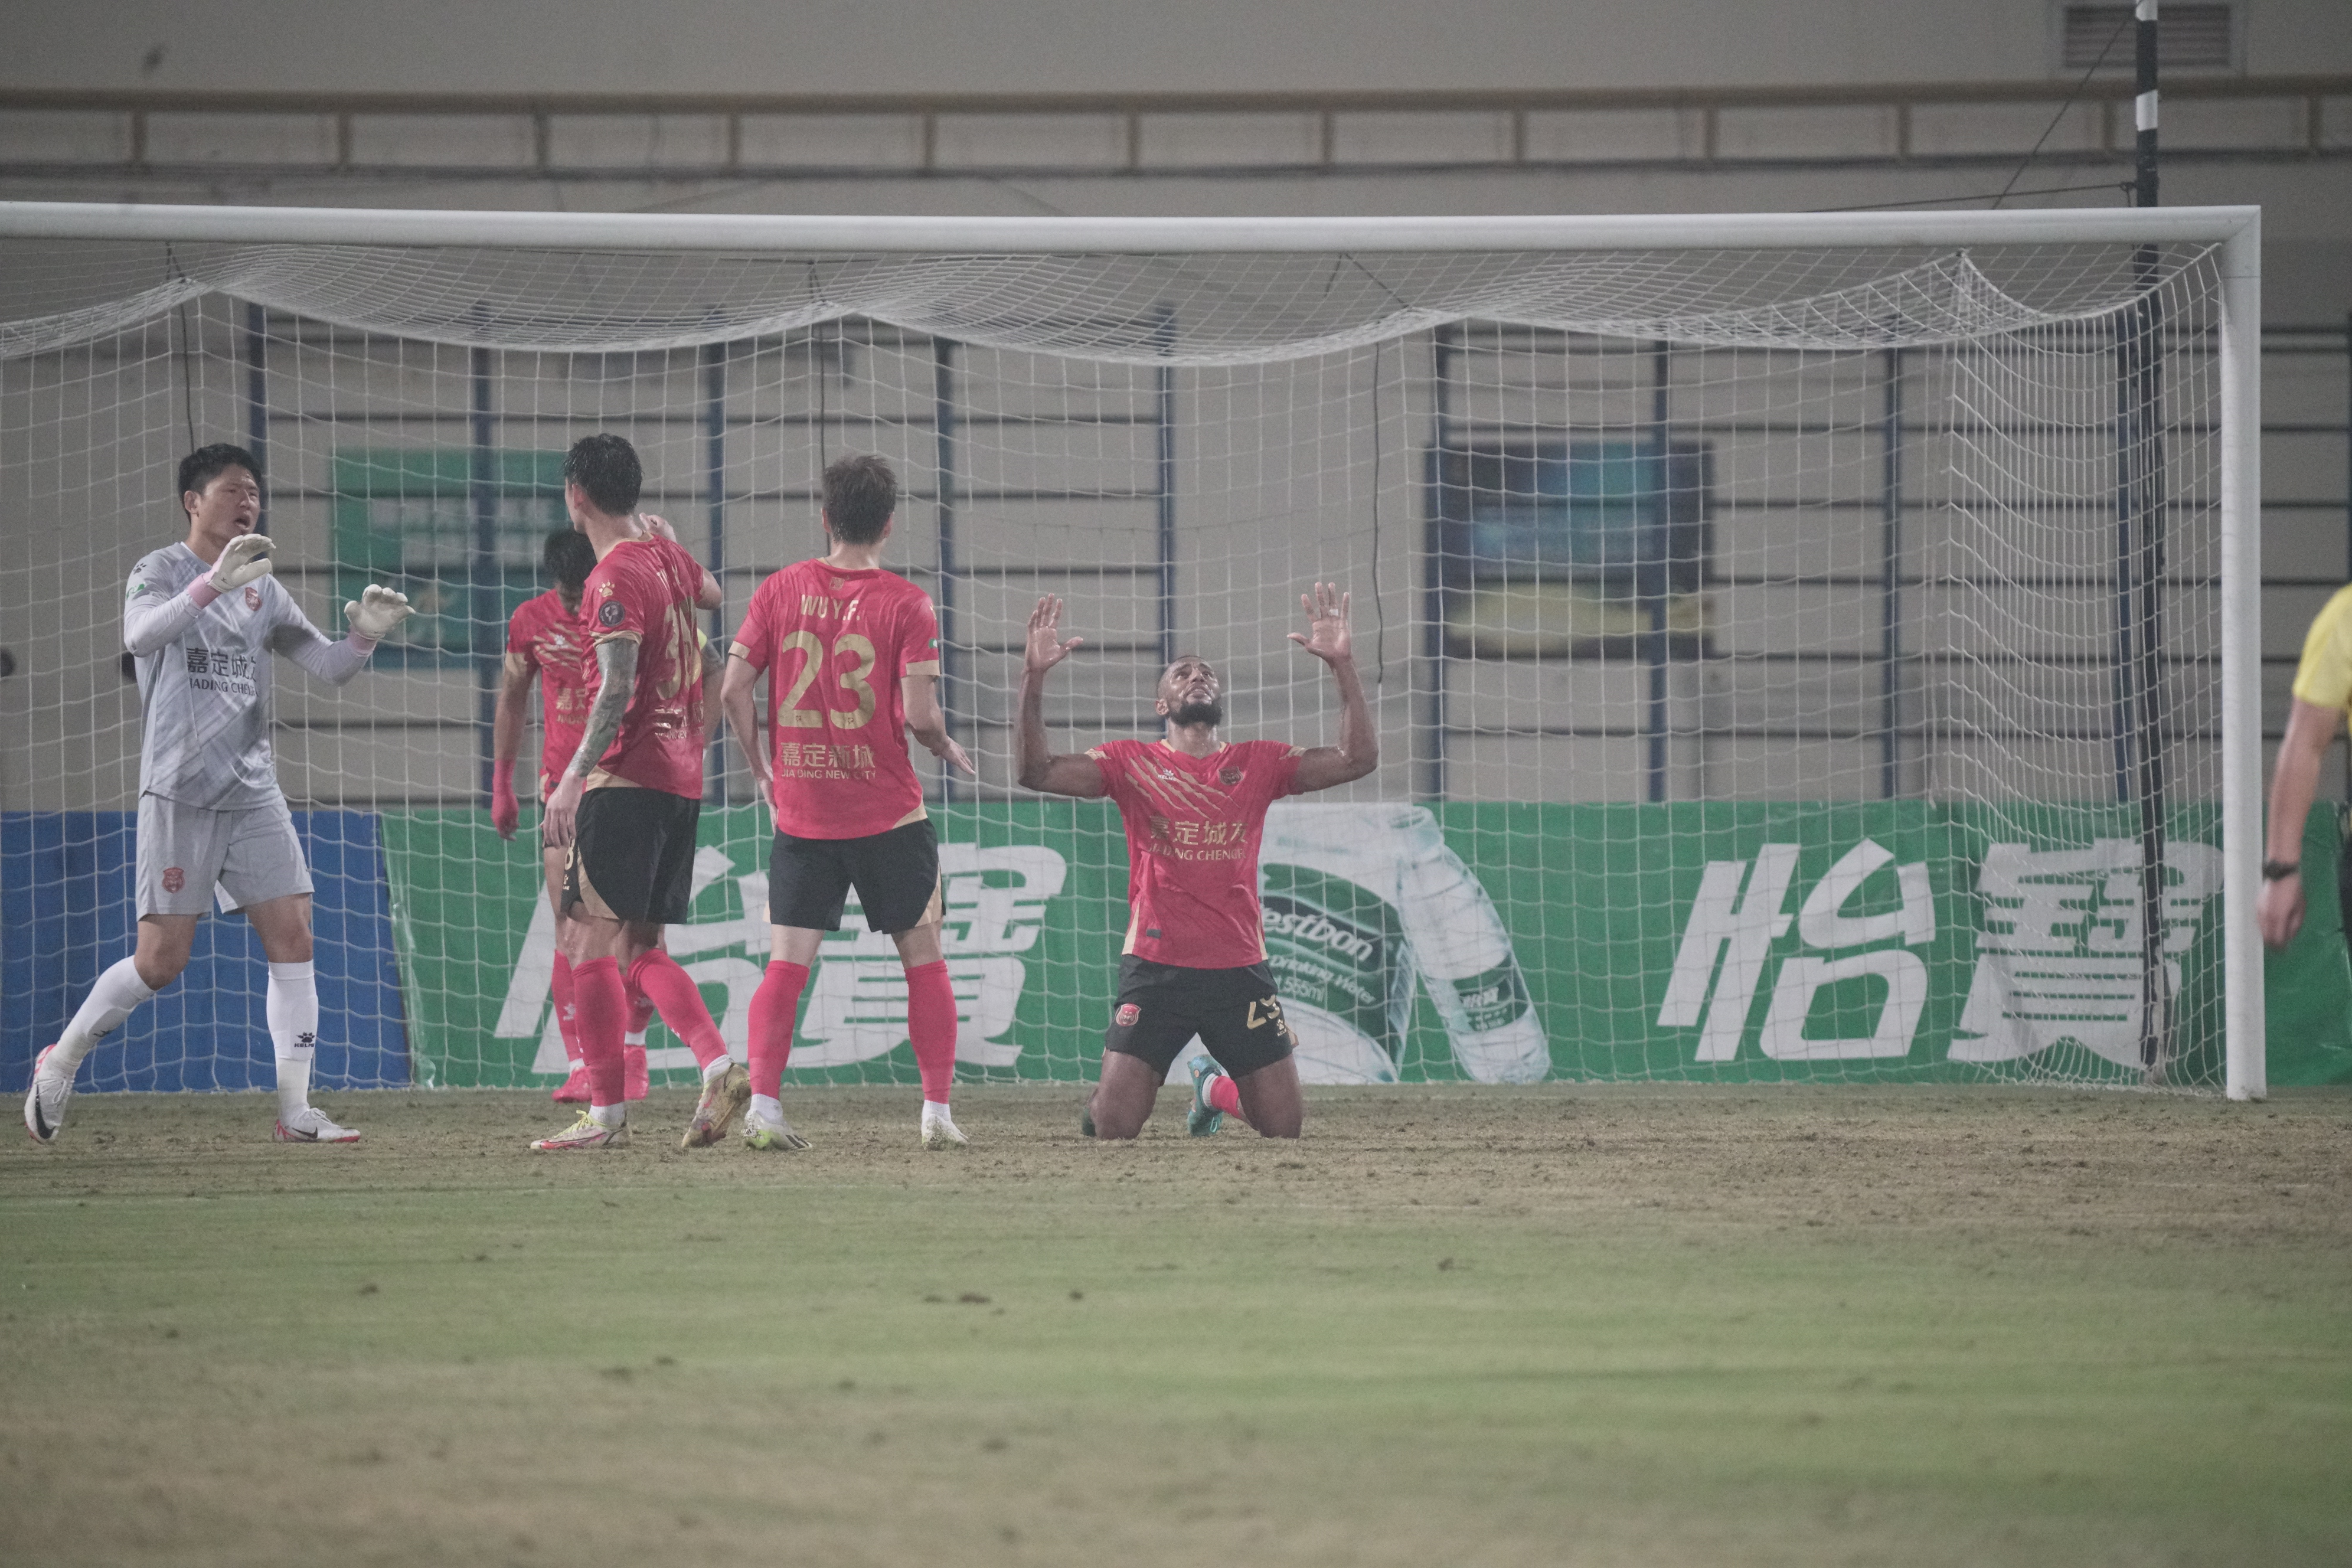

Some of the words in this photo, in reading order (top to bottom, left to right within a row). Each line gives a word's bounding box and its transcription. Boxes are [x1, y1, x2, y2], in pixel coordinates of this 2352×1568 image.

[801, 594, 829, 618] WU
[832, 597, 860, 621] Y.F.
[189, 677, 228, 692] IADING
[778, 629, 876, 730] 23
[780, 741, 876, 769] 嘉定新城
[825, 770, 850, 779] NEW
[1262, 907, 1373, 962] estbon
